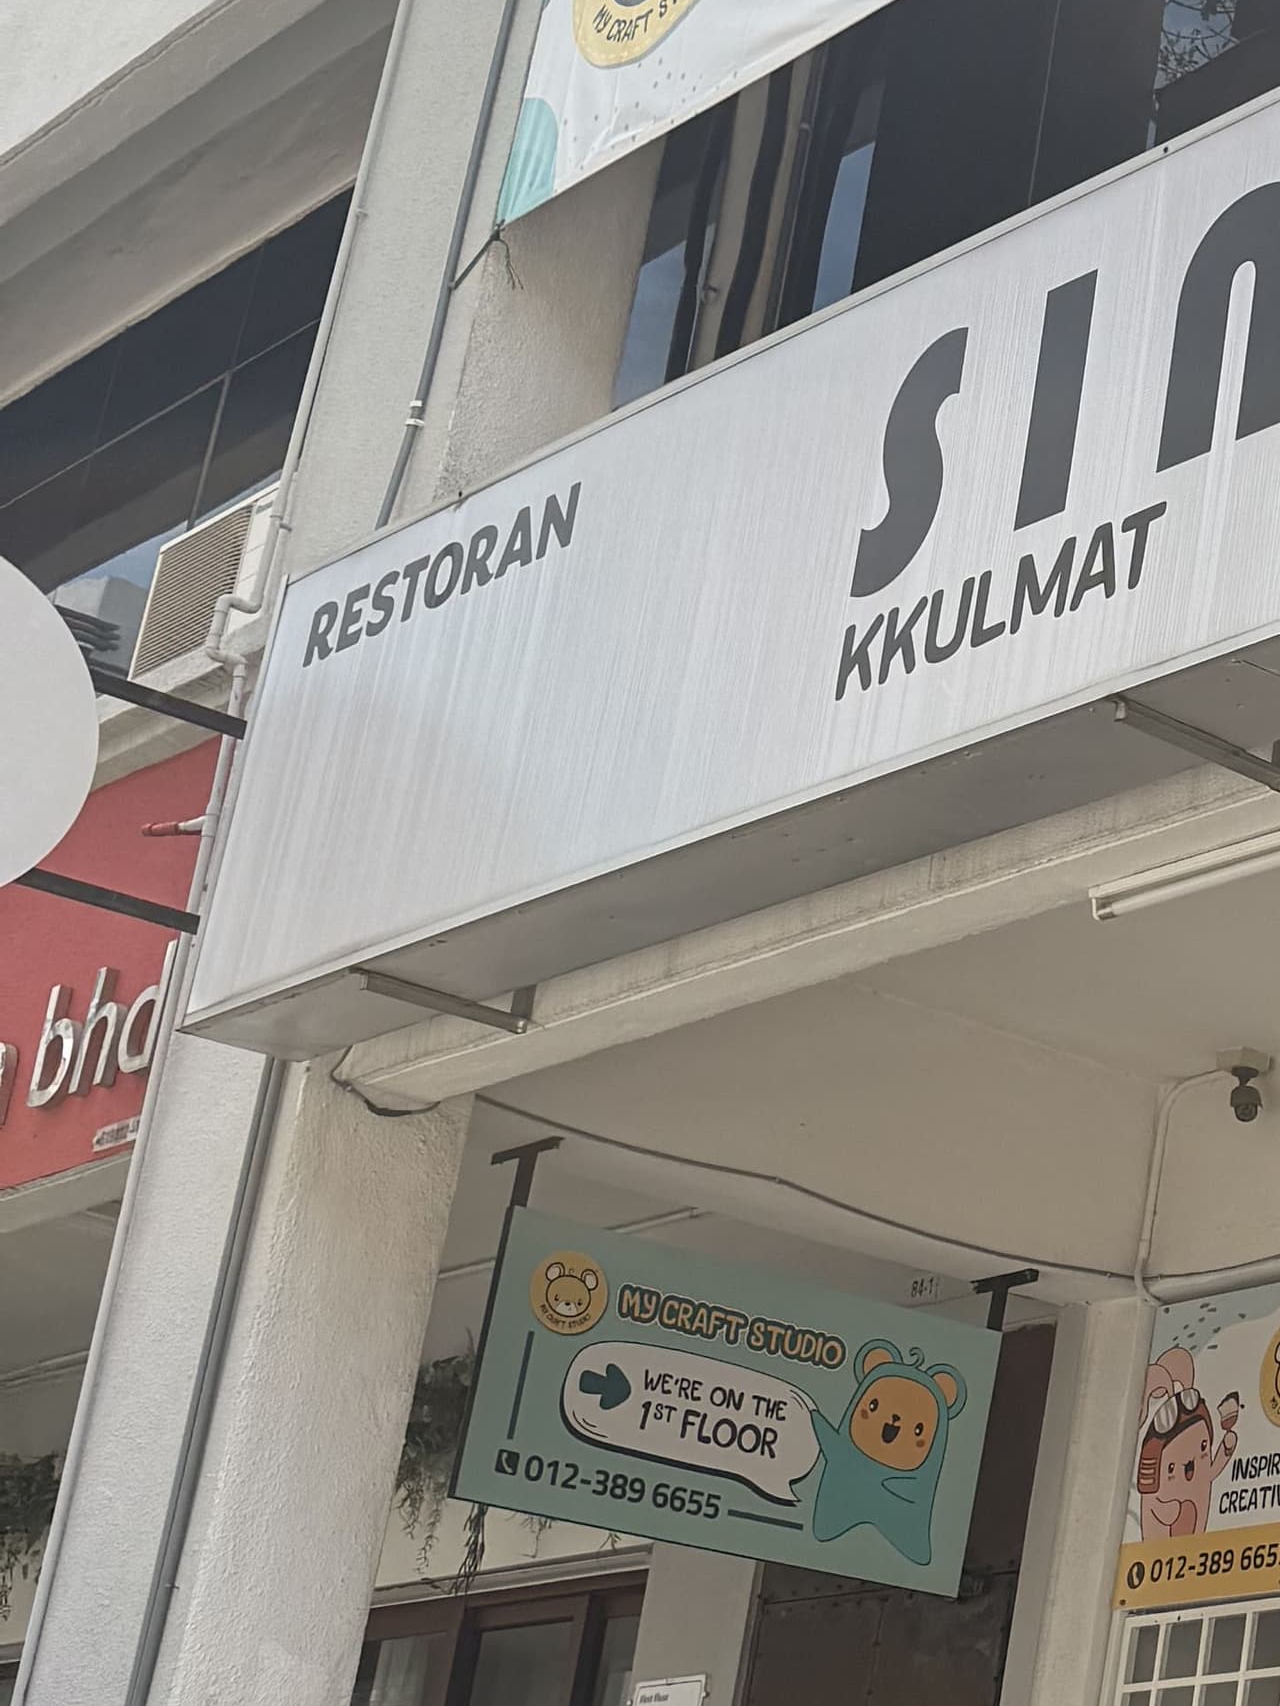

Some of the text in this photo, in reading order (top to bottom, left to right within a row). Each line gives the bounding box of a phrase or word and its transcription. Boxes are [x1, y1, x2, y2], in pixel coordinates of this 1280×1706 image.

[301, 481, 581, 668] RESTORAN
[836, 500, 1168, 701] KKULMAT
[26, 939, 178, 1109] bhd
[618, 1285, 846, 1369] MY CRAFT STUDIO
[644, 1368, 787, 1422] WE'RE ON THE
[680, 1408, 778, 1458] FLOOR
[524, 1457, 721, 1519] 012-389 6655
[1149, 1549, 1234, 1583] 012-389
